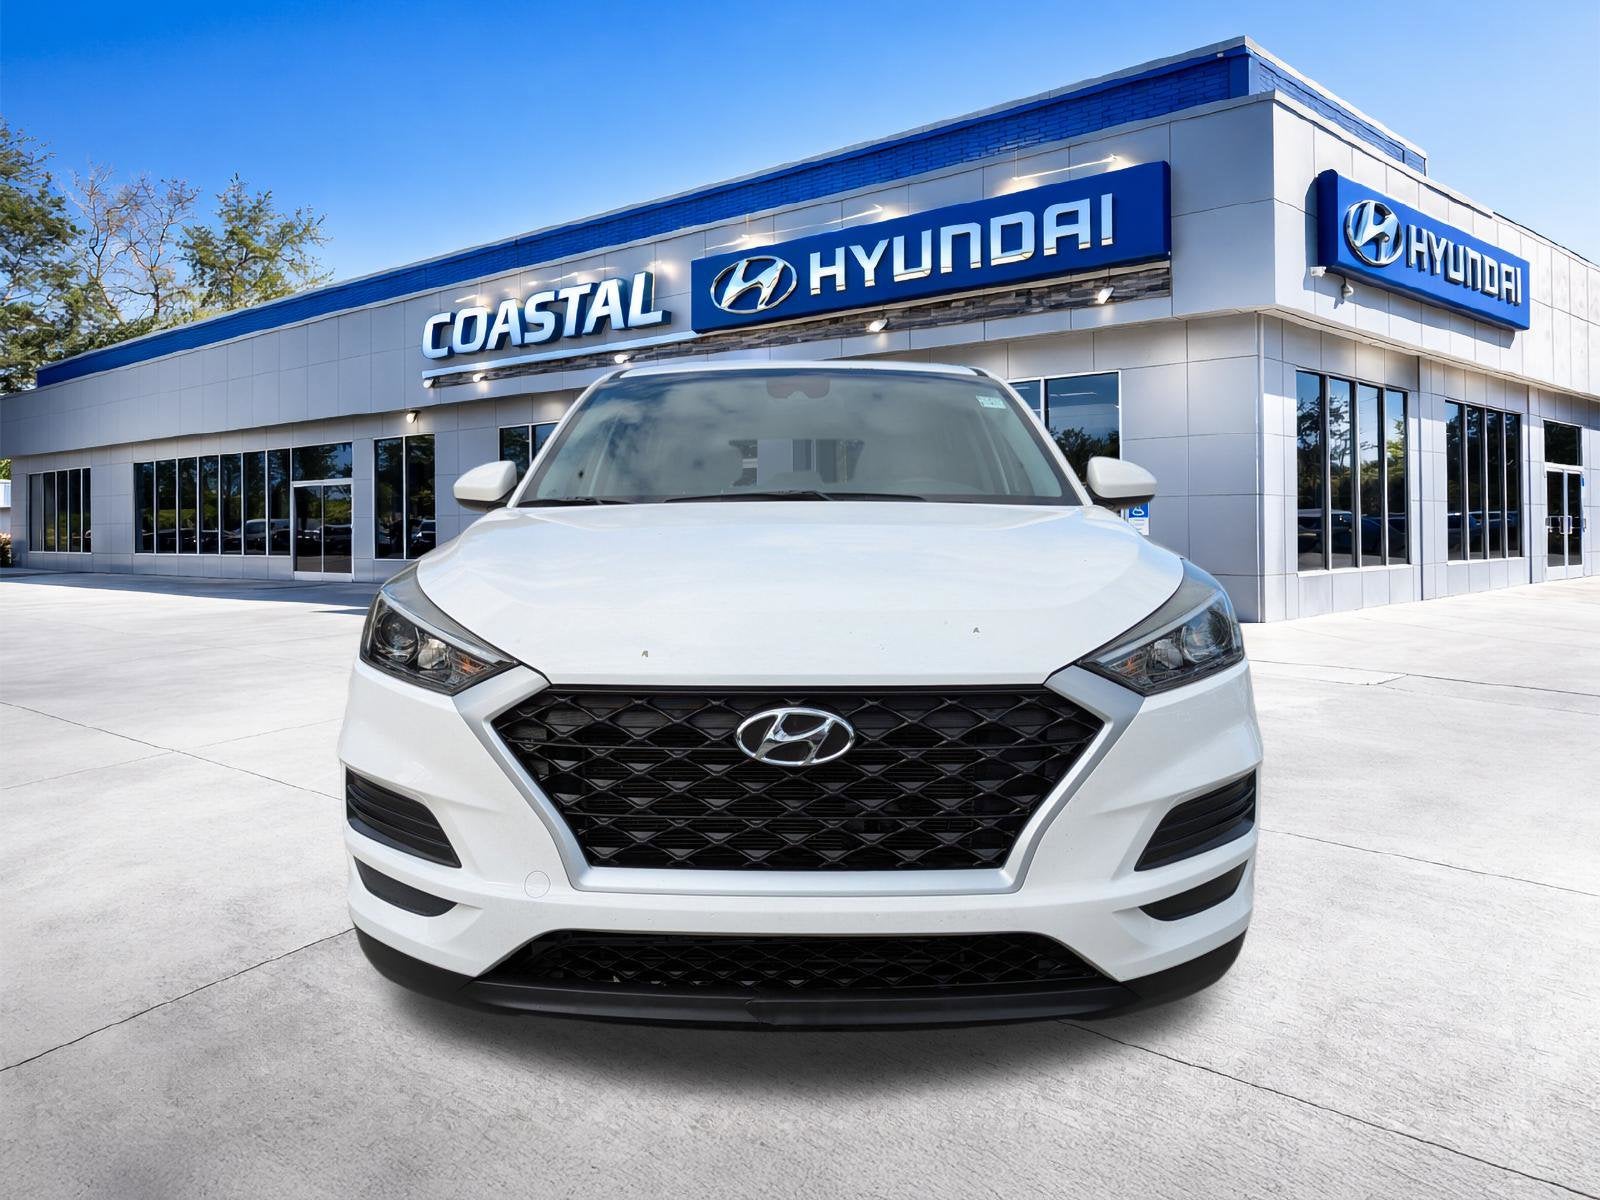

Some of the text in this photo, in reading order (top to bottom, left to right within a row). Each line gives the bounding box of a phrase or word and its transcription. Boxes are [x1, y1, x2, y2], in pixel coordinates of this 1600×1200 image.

[809, 193, 1113, 295] HYUNDAI
[1406, 224, 1522, 306] HYUNDAI
[422, 271, 668, 359] COASTAL
